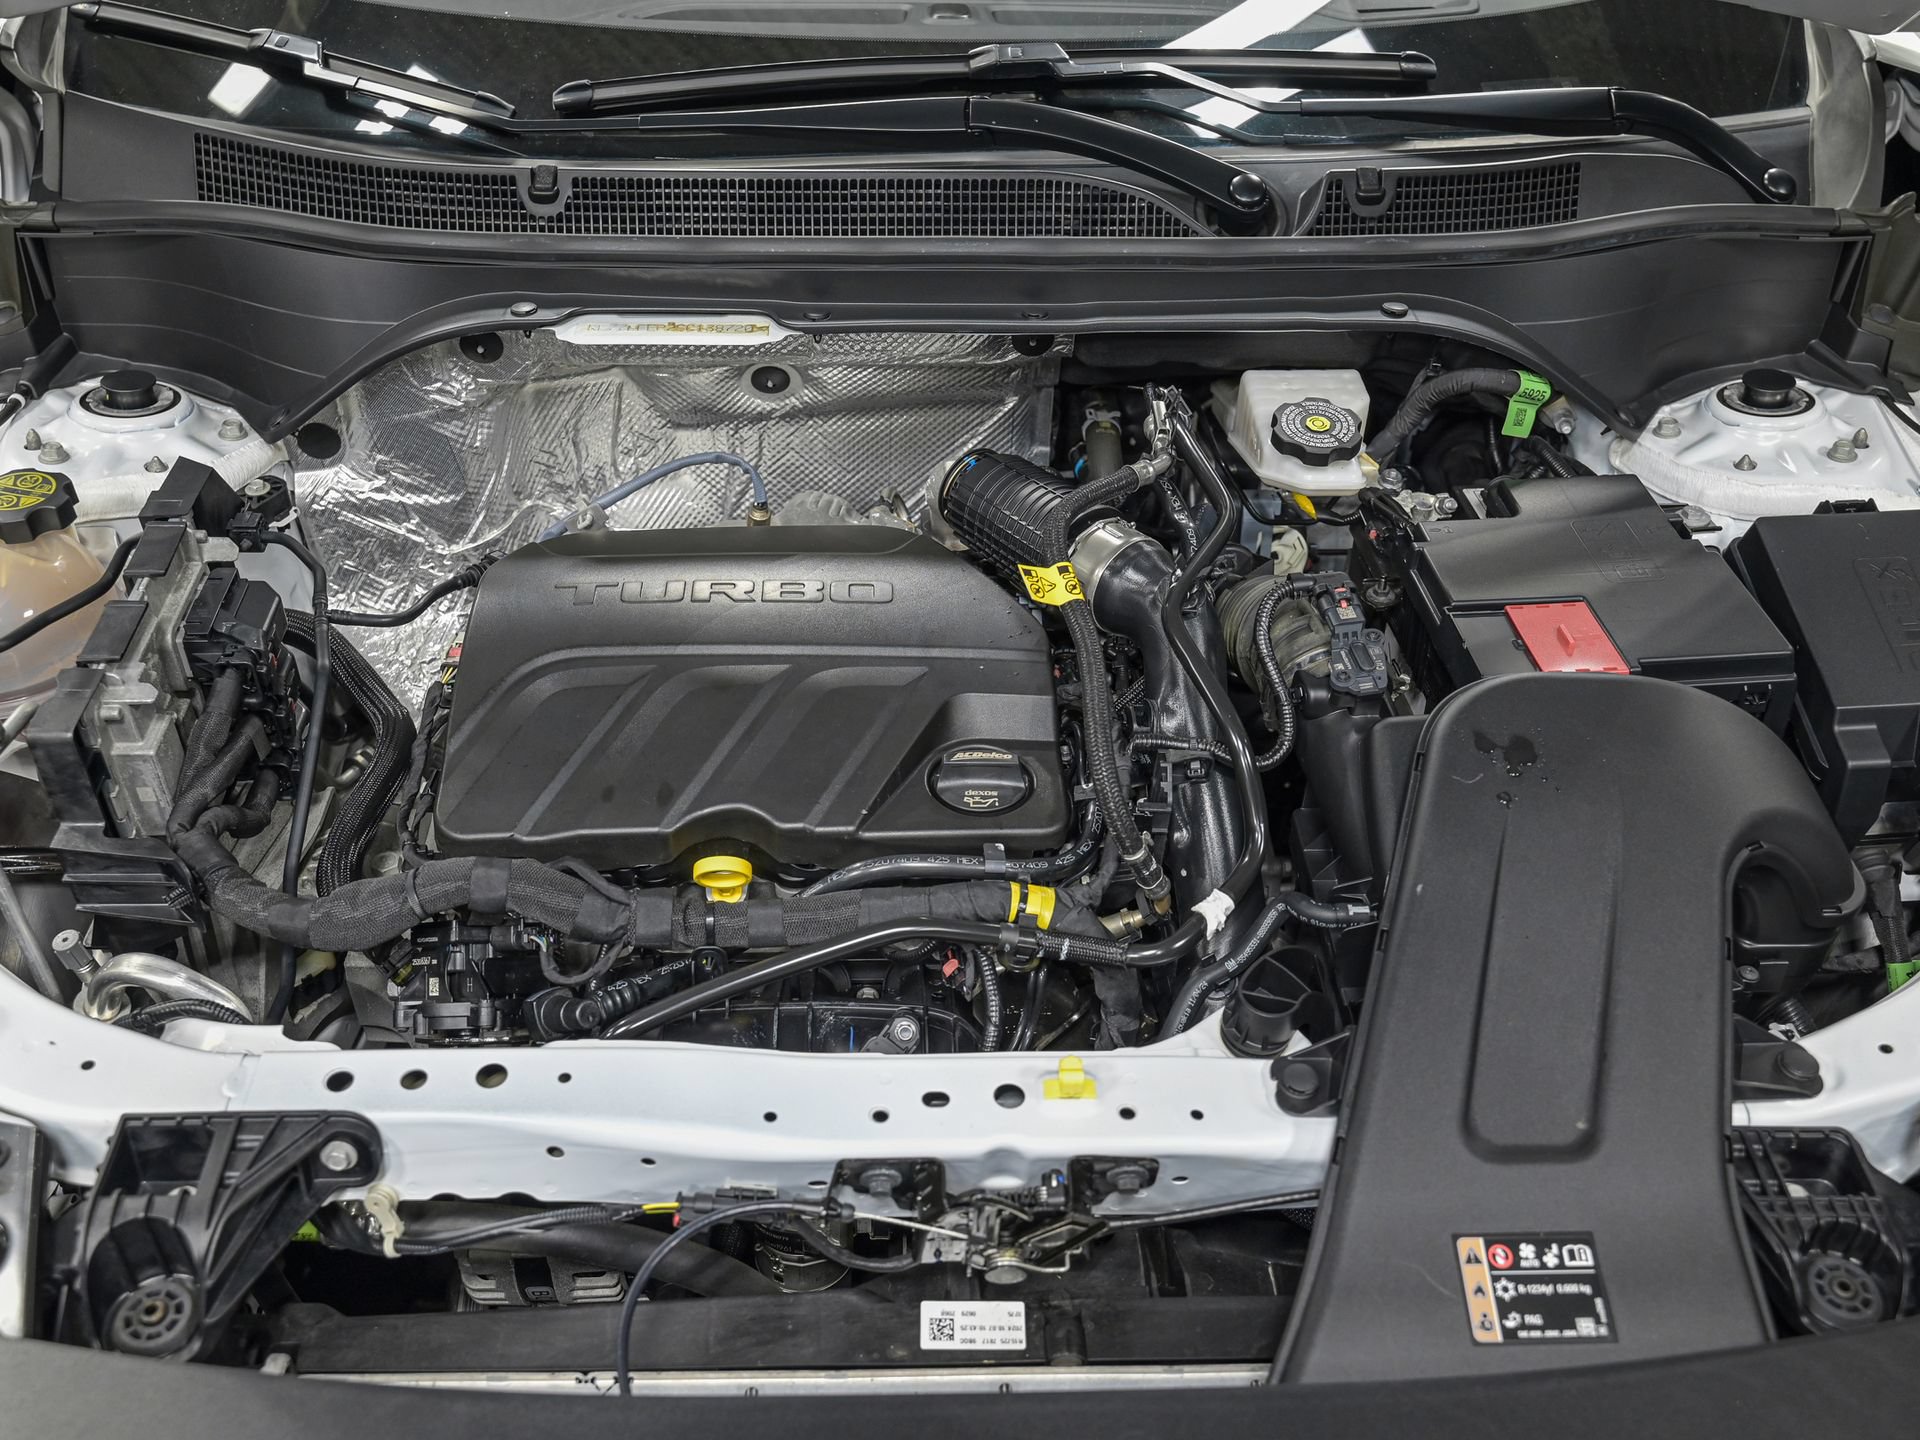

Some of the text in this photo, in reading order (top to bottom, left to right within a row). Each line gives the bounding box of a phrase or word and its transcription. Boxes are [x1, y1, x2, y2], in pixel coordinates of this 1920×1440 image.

[554, 579, 894, 606] TURBO
[950, 751, 1012, 761] ACDelco
[926, 854, 950, 864] 425
[955, 855, 980, 866] MEX
[1055, 853, 1077, 866] 425
[1078, 838, 1096, 856] MEX
